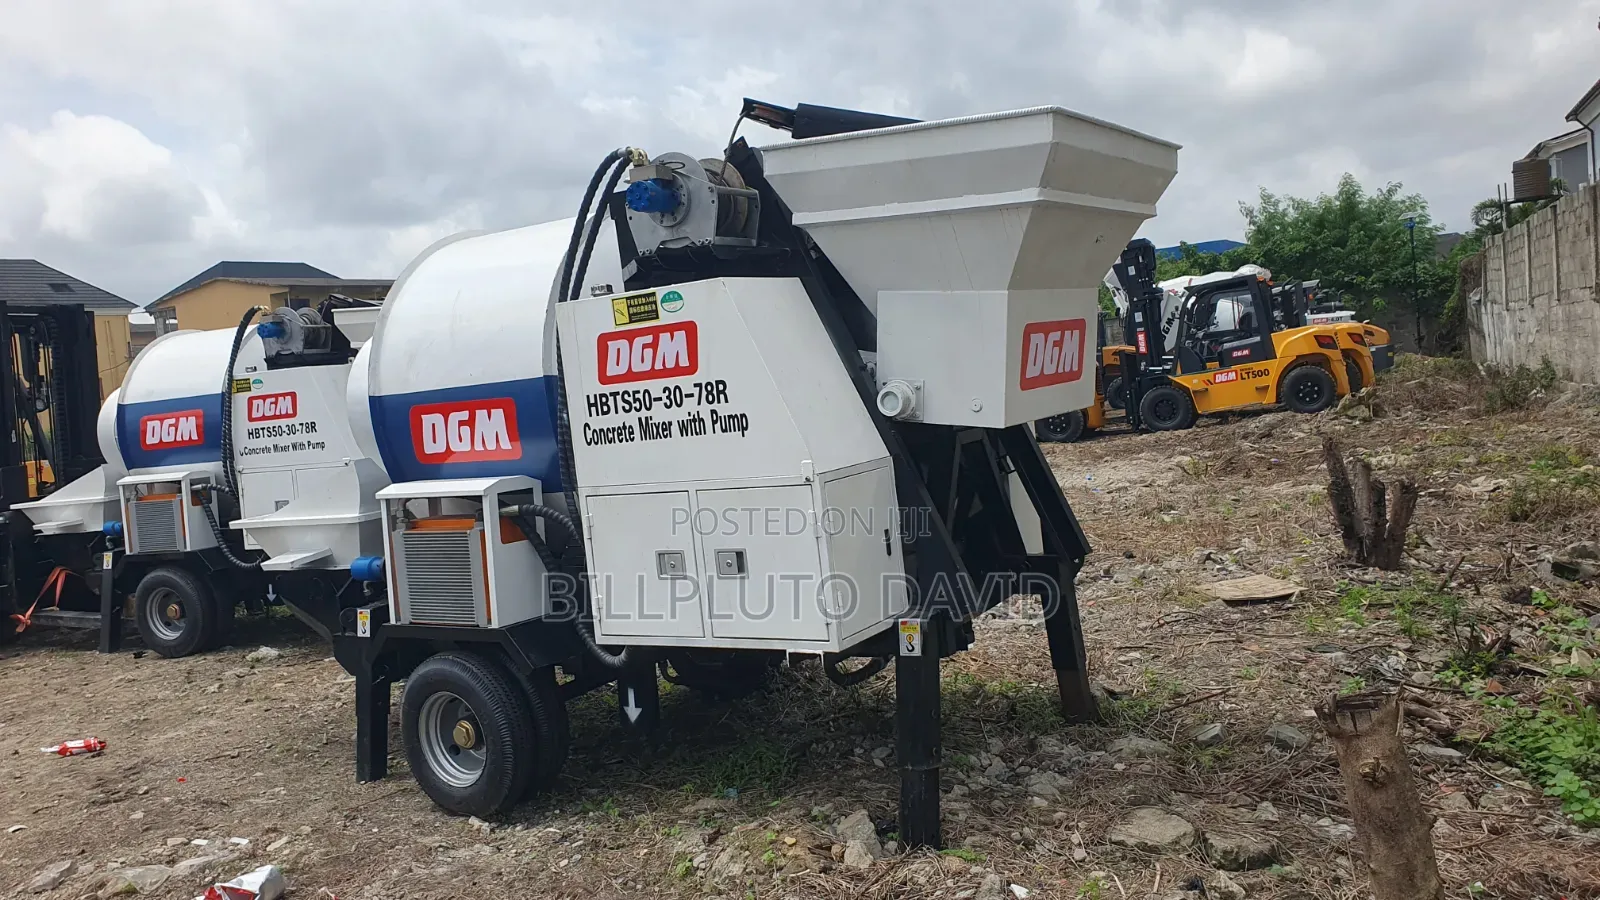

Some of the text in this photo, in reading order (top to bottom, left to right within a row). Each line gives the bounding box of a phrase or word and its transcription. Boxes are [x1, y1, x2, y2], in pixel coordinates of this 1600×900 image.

[606, 330, 690, 377] DGM
[1025, 329, 1080, 379] DGM
[1137, 333, 1146, 352] DGM
[1215, 371, 1237, 383] DGM
[1240, 368, 1270, 381] LT500
[251, 395, 294, 418] DGM
[586, 379, 729, 417] HBTS50-30-78R
[145, 416, 199, 445] DGM
[247, 421, 318, 440] HBTS50-30-78R
[420, 408, 513, 455] DGM
[583, 408, 749, 447] Concrete Mixer with Pump
[244, 440, 326, 456] Concrete Mixer With Pump
